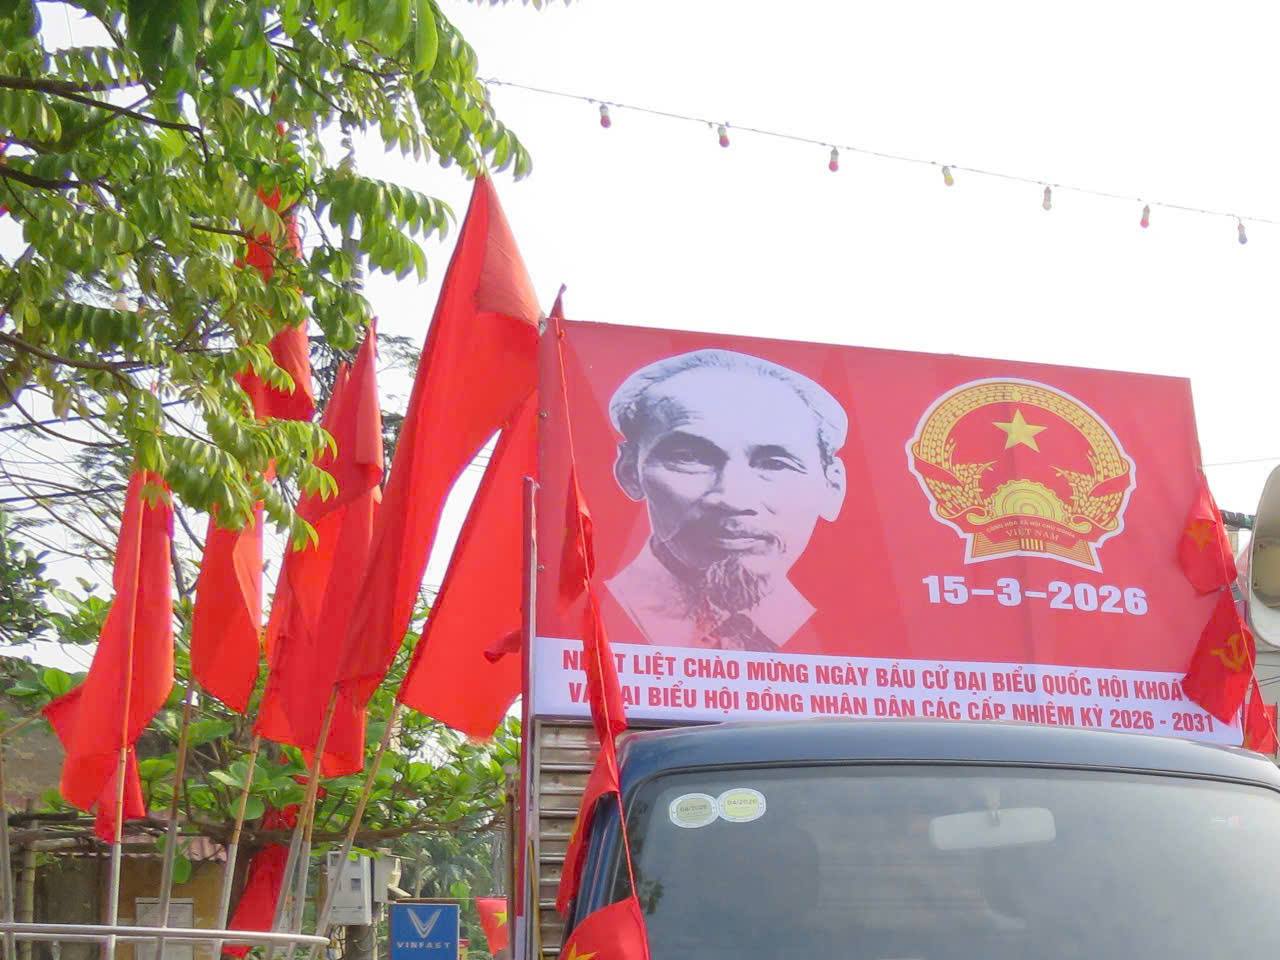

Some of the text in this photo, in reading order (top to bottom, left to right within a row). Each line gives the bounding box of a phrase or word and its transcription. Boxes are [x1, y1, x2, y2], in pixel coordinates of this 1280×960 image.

[922, 575, 1149, 615] 15-3-2026
[633, 651, 677, 681] LIỆT
[683, 656, 740, 680] CHÀO
[747, 658, 809, 684] MỪNG
[815, 662, 869, 687] NGÀY
[876, 662, 916, 689] BẦU
[922, 664, 950, 690] CỬ
[954, 671, 987, 695] ĐẠI
[992, 666, 1037, 693] BIỂU
[1042, 670, 1092, 697] QUỐC
[1097, 675, 1129, 702] HỘI
[619, 685, 641, 709] ẠI
[648, 680, 697, 708] BIỂU
[704, 687, 739, 714] HỘI
[746, 686, 804, 713] ĐỒNG
[810, 692, 868, 716] NHÂN
[874, 694, 916, 718] DÂN
[922, 696, 961, 720] CÁC
[967, 696, 1006, 720] CẤP
[1080, 704, 1103, 728] KỲ
[1110, 709, 1154, 730] 2026
[1172, 712, 1214, 732] 2031
